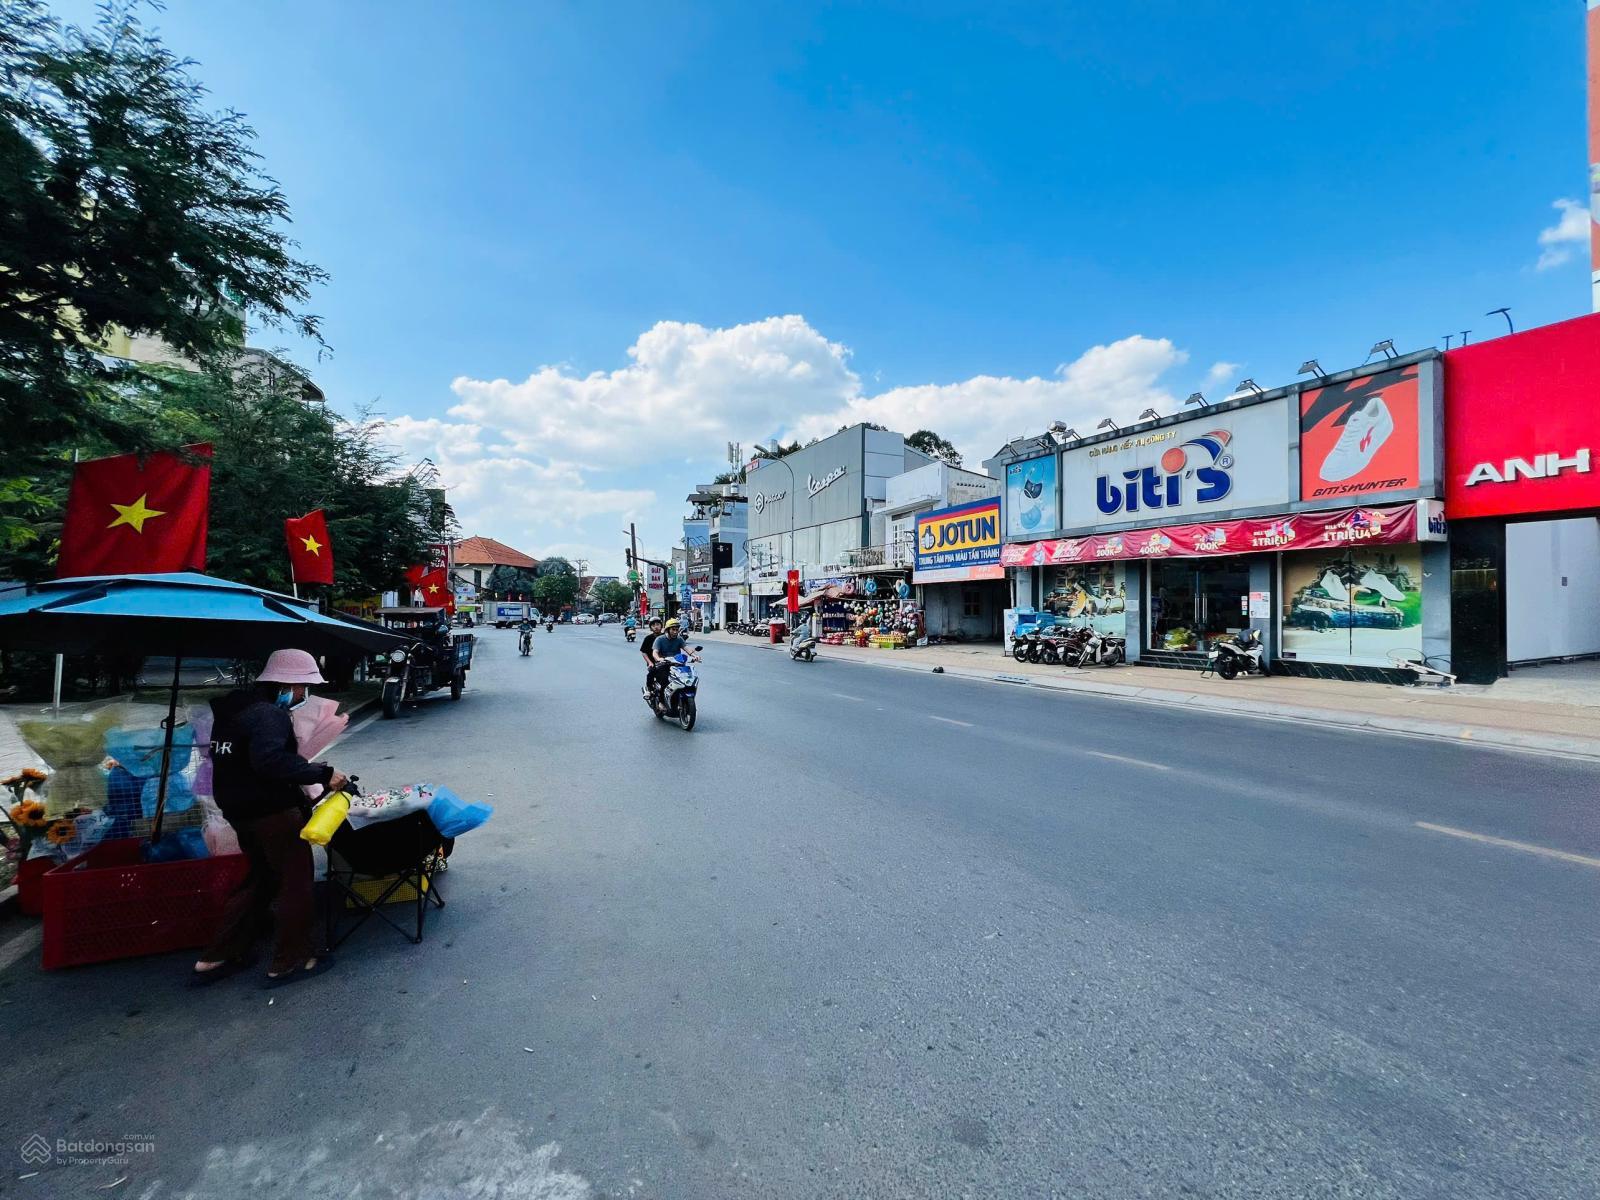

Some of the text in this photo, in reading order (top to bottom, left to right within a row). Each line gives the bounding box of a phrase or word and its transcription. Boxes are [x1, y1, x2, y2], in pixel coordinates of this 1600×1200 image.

[1464, 448, 1590, 487] ANH
[808, 465, 847, 499] Vespa
[937, 516, 996, 548] JOTUN
[1096, 548, 1114, 557] 200K
[1140, 545, 1160, 554] 400K
[1194, 541, 1218, 551] 700K
